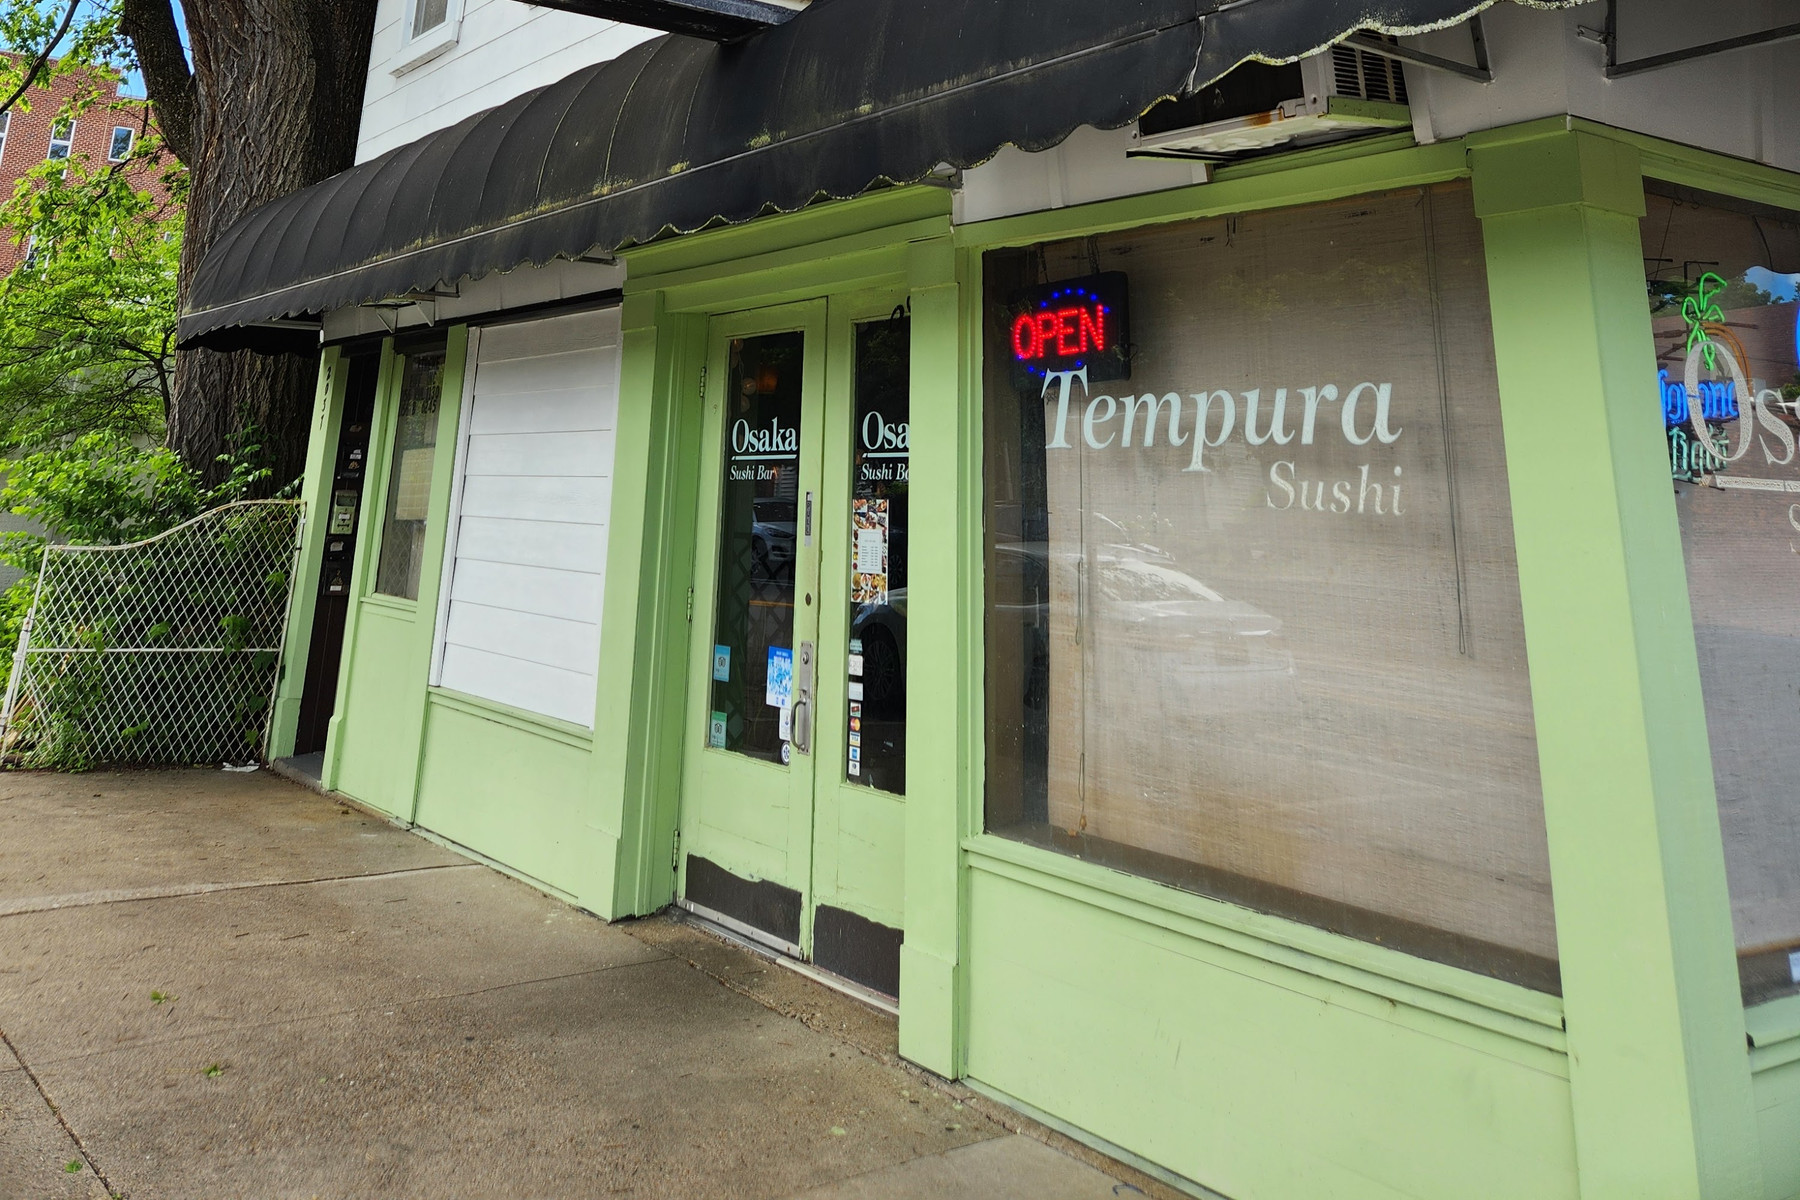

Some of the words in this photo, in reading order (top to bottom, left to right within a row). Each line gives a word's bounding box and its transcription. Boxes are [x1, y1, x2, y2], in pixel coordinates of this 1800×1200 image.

[1011, 303, 1105, 360] OPEN
[1041, 364, 1403, 472] Tempura
[1684, 341, 1800, 465] Os
[731, 416, 798, 453] Osaka
[729, 464, 755, 481] Sushi
[756, 465, 774, 480] Bar
[860, 463, 893, 481] Sushi
[1266, 460, 1406, 516] Sushi
